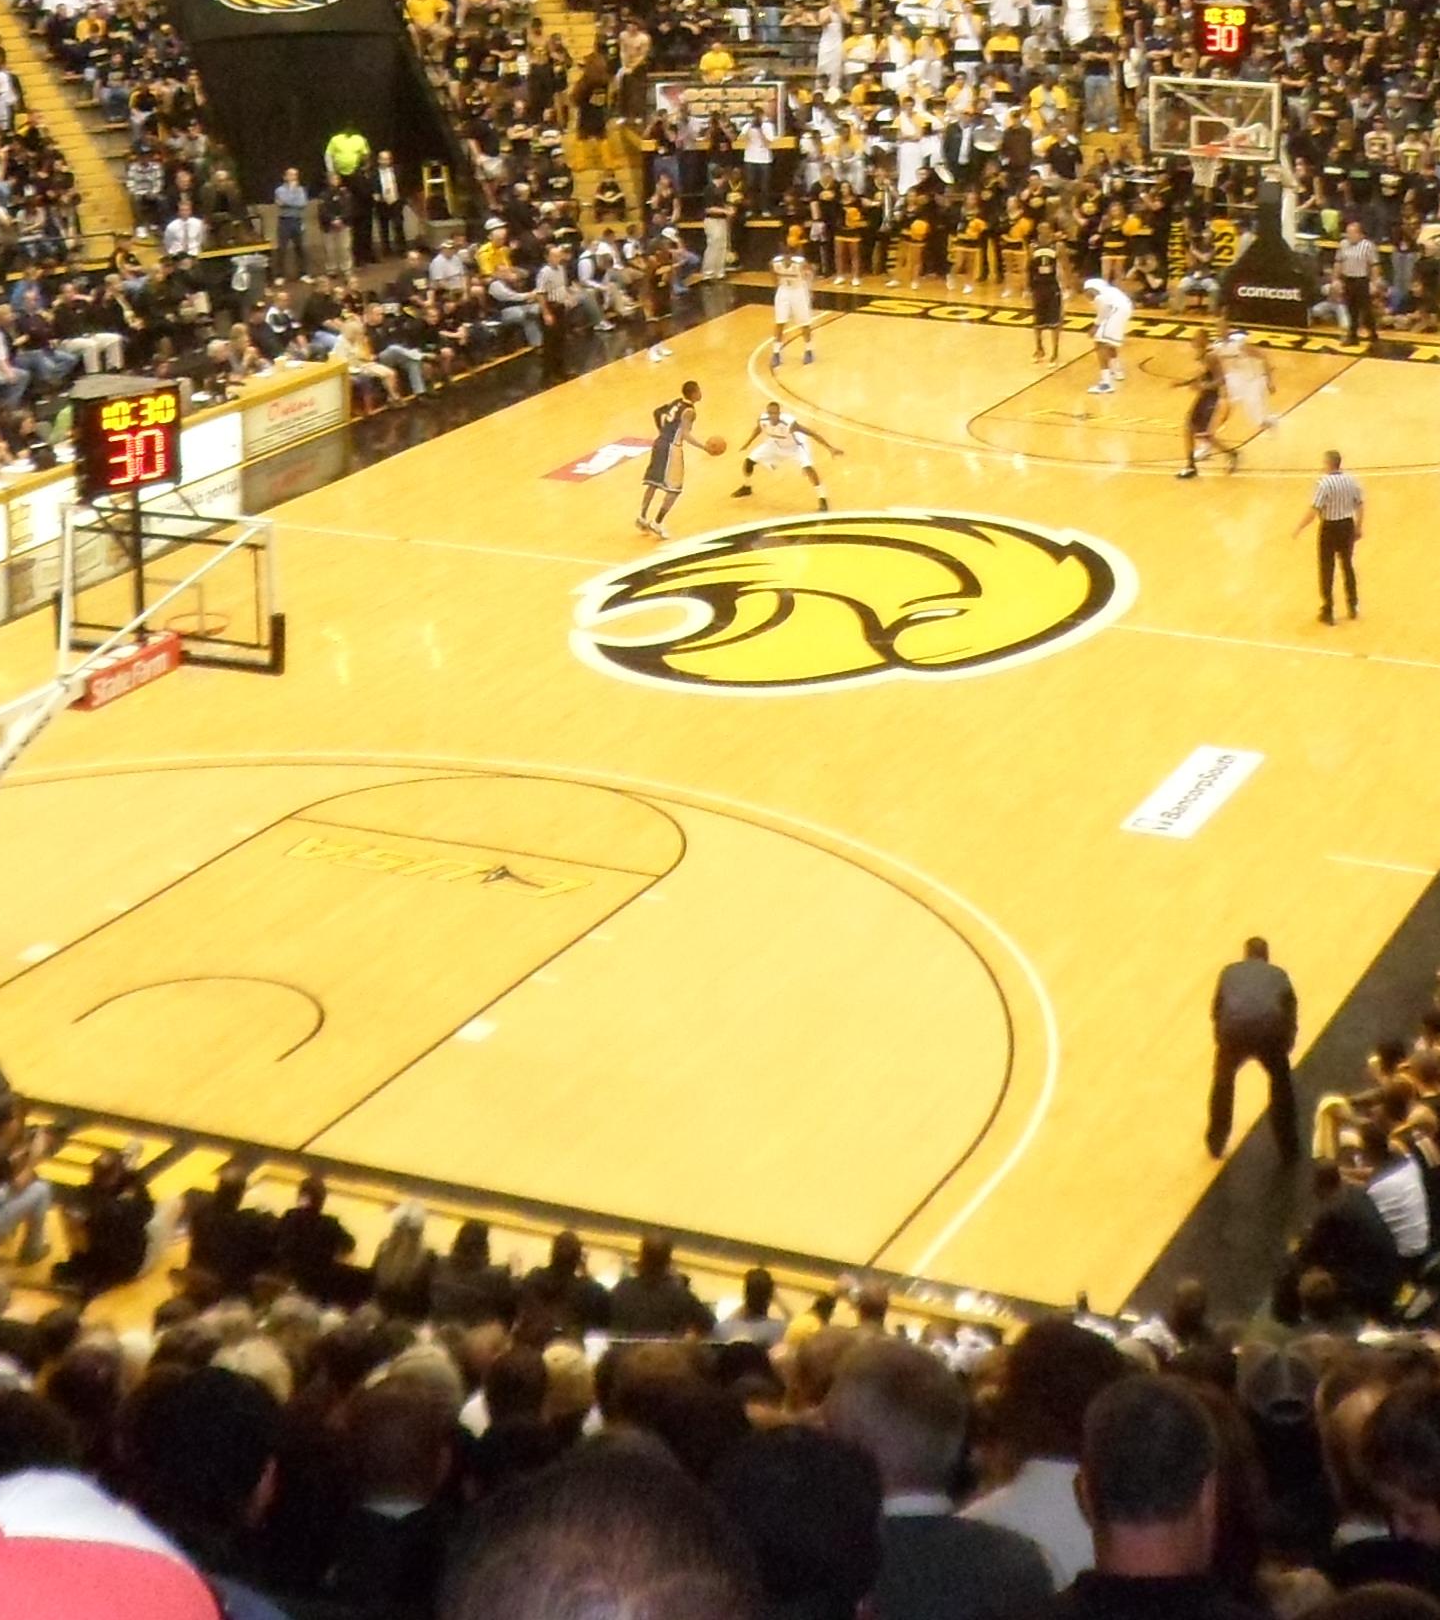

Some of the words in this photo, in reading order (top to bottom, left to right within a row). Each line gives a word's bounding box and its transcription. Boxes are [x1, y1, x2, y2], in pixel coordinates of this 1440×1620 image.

[1207, 25, 1239, 52] 30
[1238, 285, 1303, 302] comcast
[108, 429, 166, 486] 30
